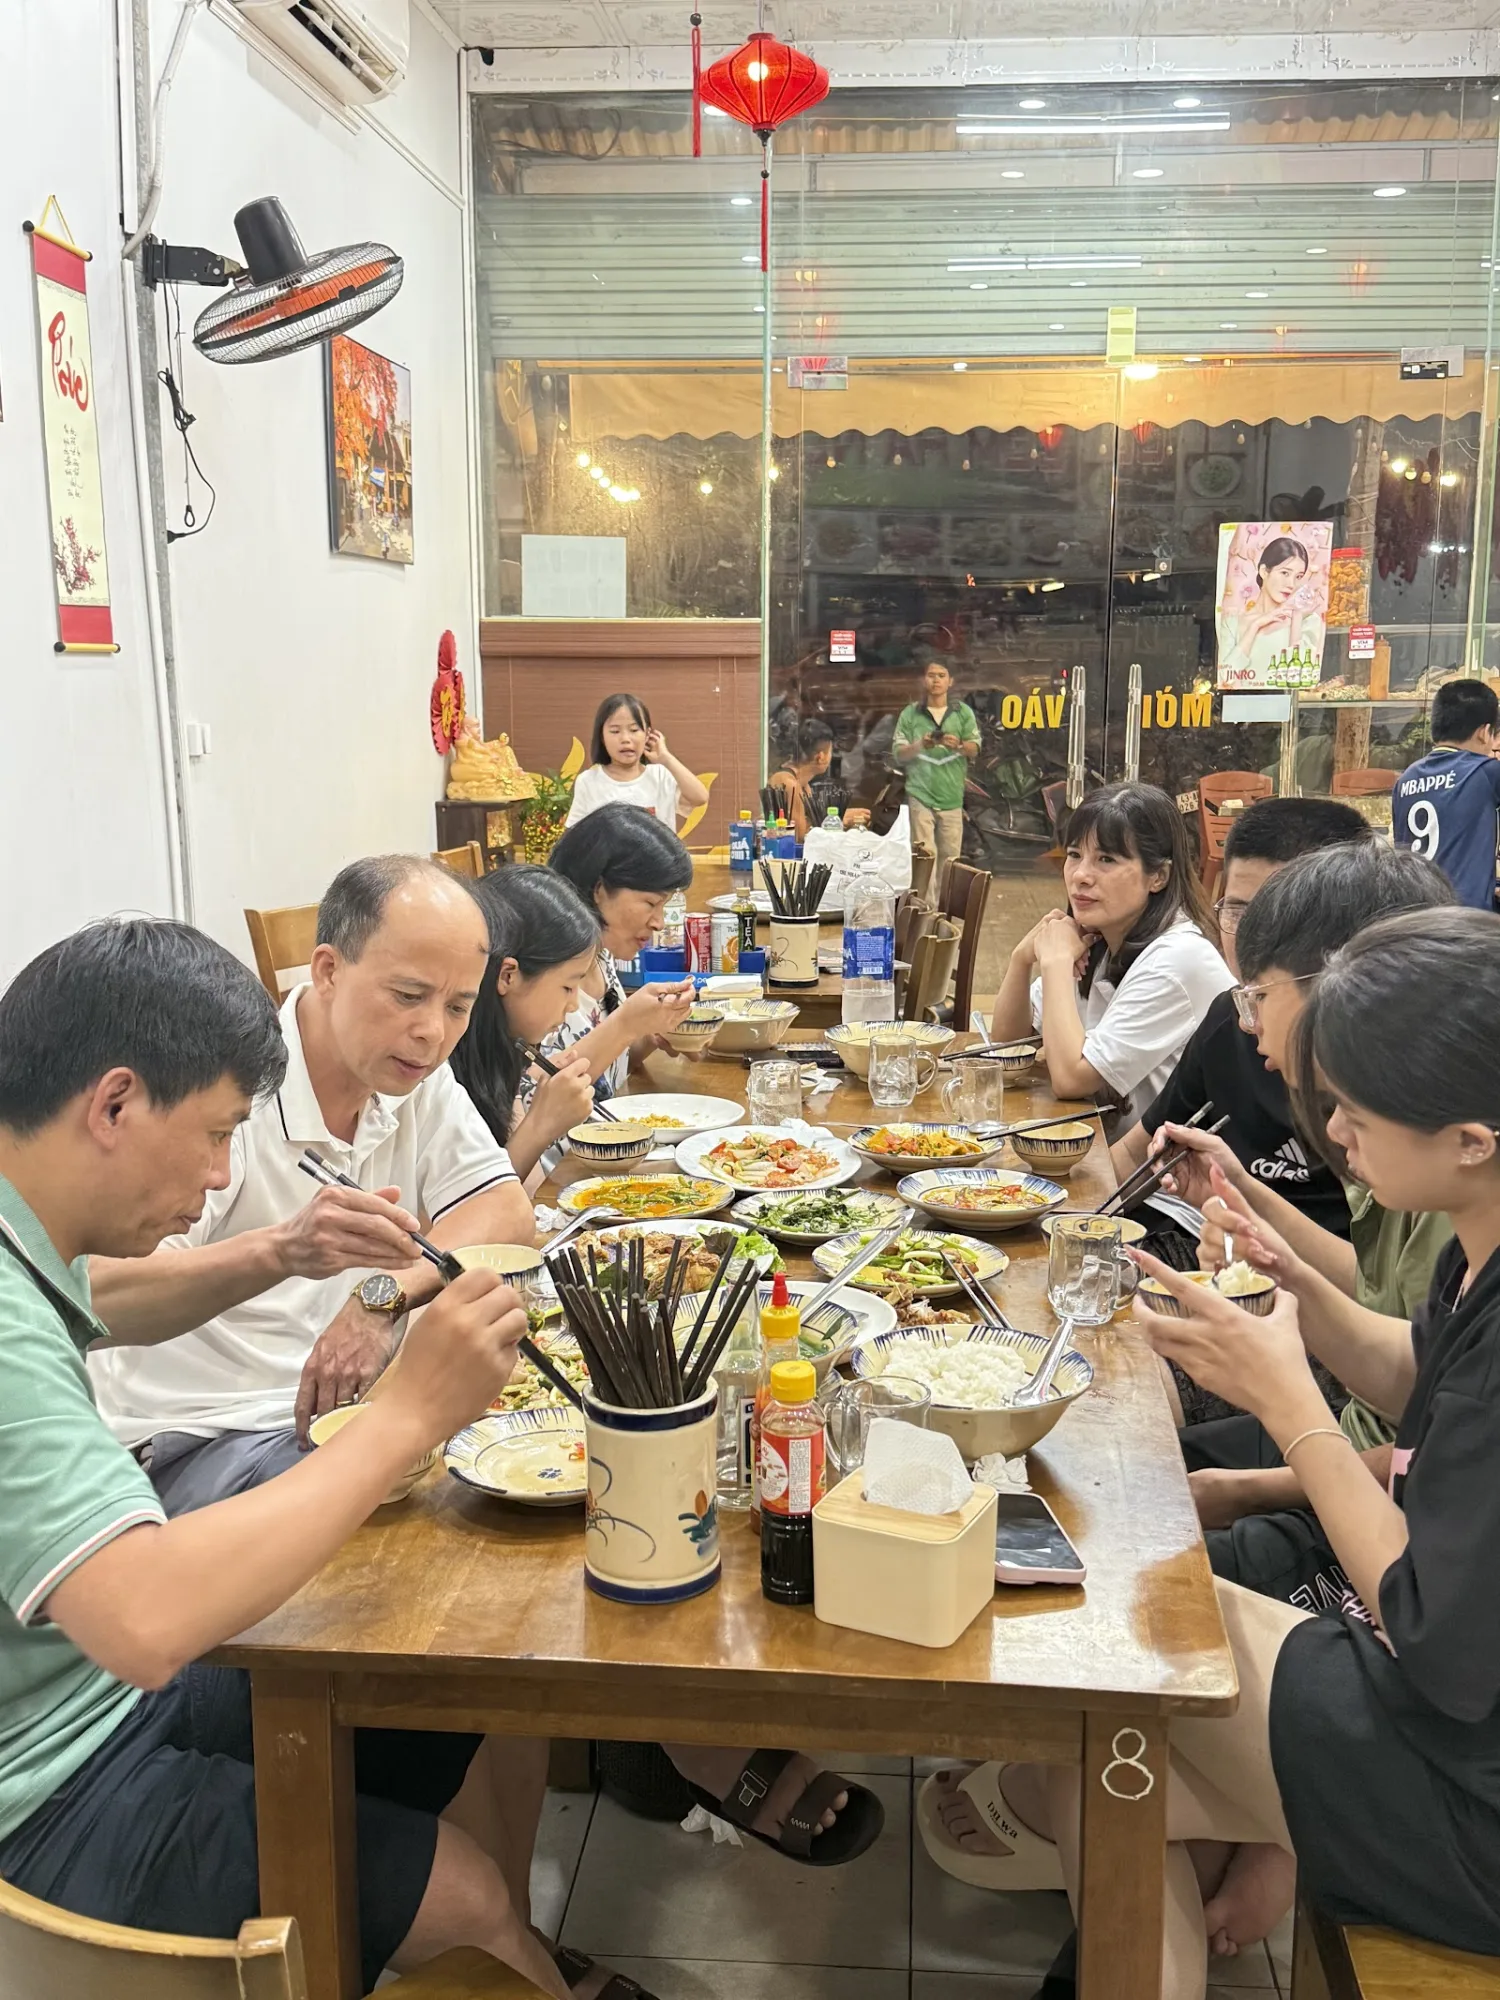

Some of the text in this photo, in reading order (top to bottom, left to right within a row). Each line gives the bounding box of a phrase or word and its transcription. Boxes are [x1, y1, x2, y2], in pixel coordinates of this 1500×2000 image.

[1226, 669, 1256, 683] JINRO
[1400, 770, 1456, 798] MBAPPÉ
[1407, 800, 1439, 861] 9
[1101, 1727, 1154, 1801] 8
